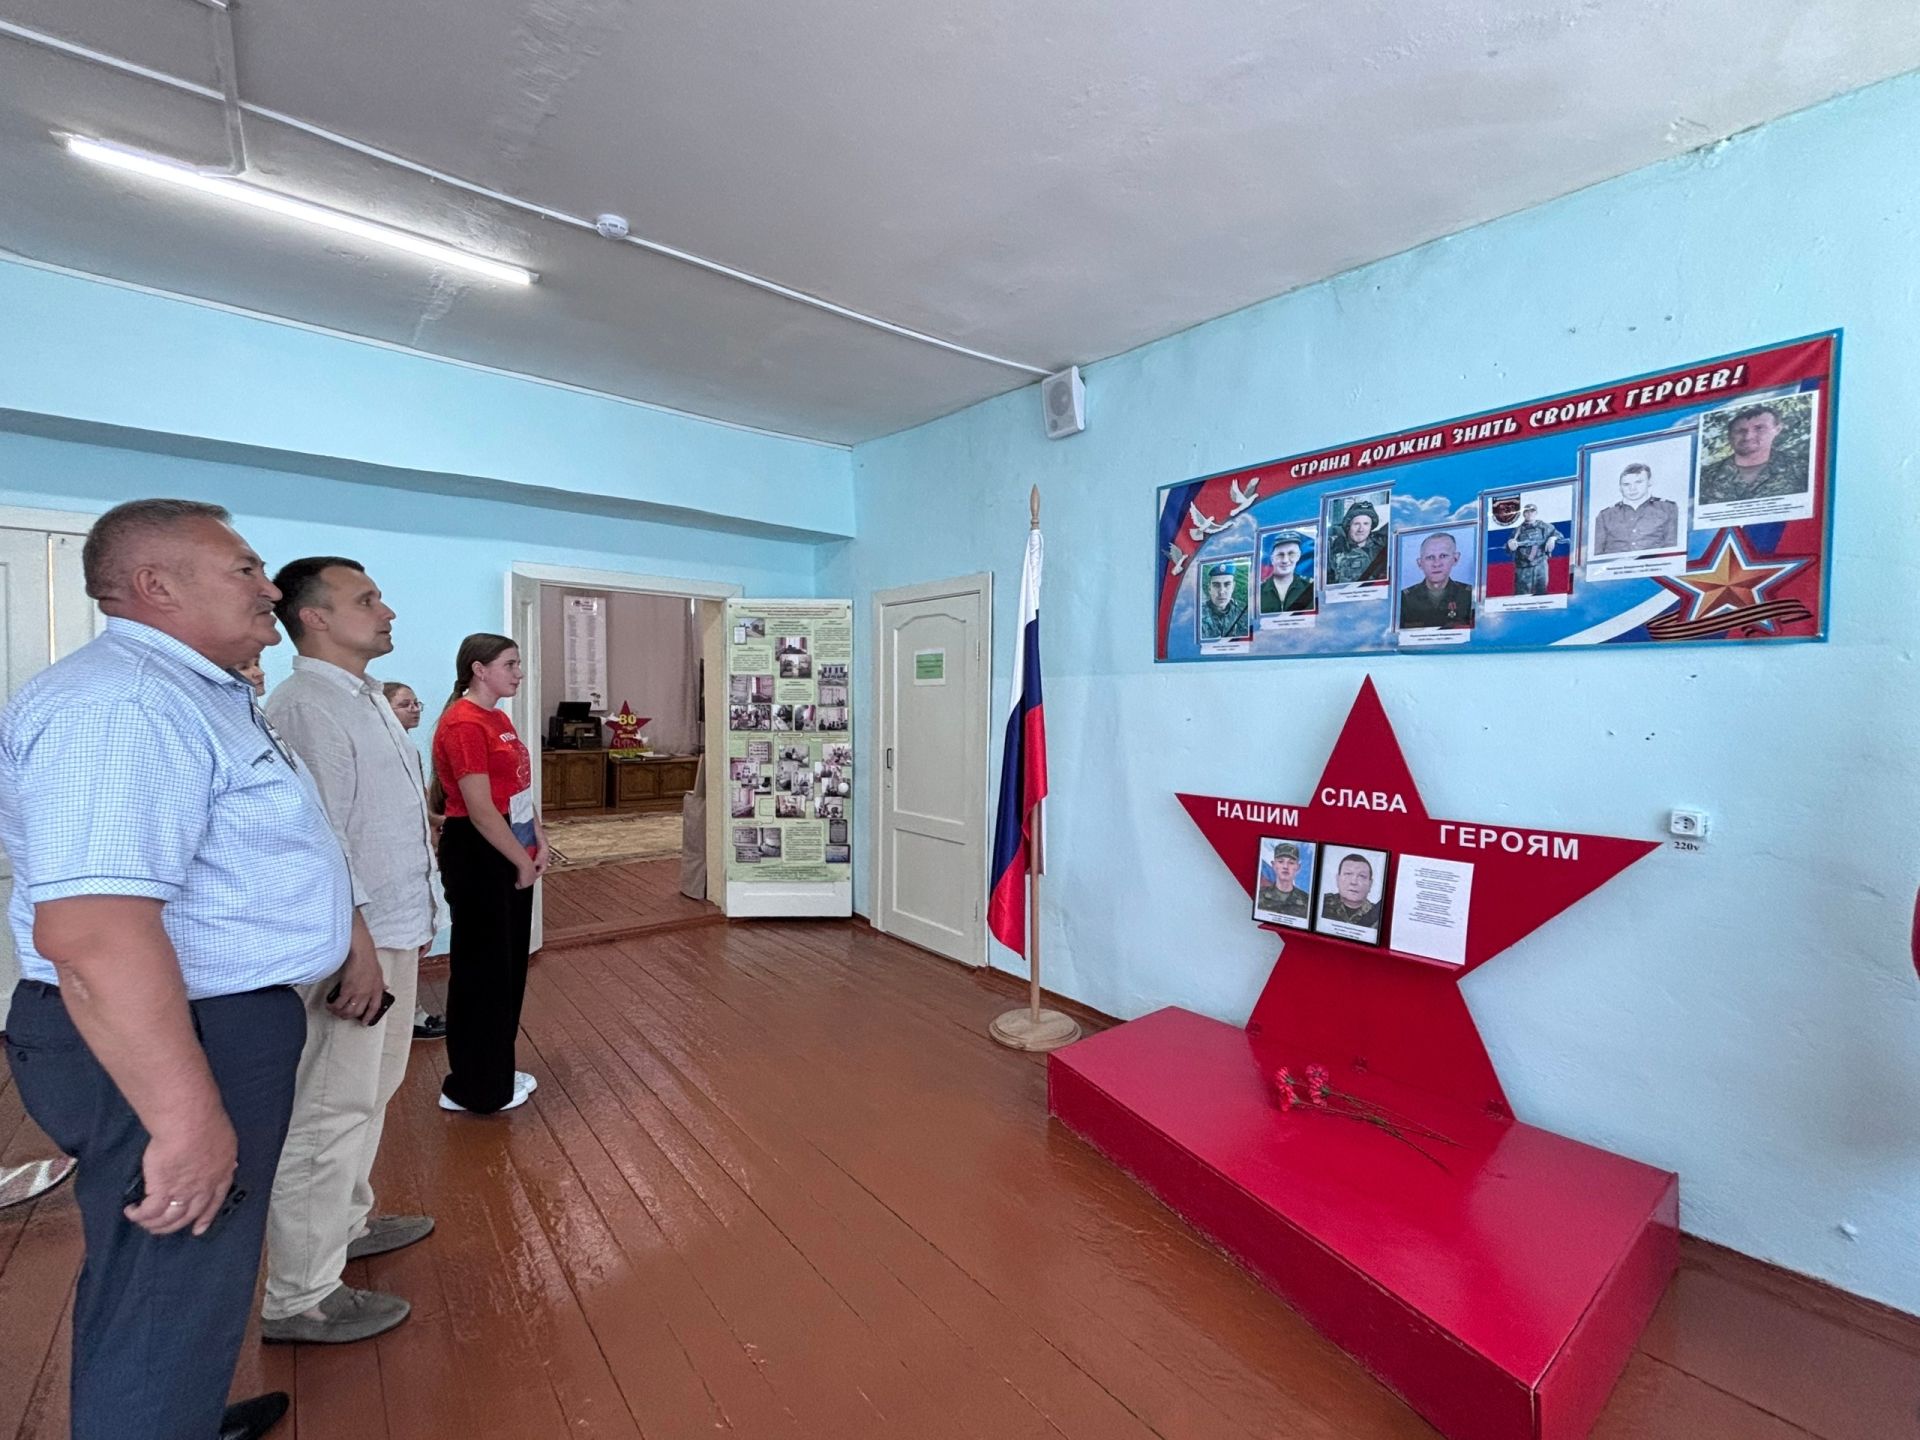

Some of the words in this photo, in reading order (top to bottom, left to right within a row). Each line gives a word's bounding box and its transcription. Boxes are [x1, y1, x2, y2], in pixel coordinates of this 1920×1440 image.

[1290, 453, 1350, 478] СТРАНА
[1357, 432, 1443, 467] ДОЛЖНА
[1452, 416, 1517, 445] ЗНАТЬ
[1529, 394, 1612, 428] СВОИХ
[1624, 364, 1745, 408] ГЕРОЕВ!
[1321, 787, 1408, 814] СЛАВА
[1217, 801, 1299, 827] НАШИМ
[1440, 824, 1579, 861] ГЕРОЯМ
